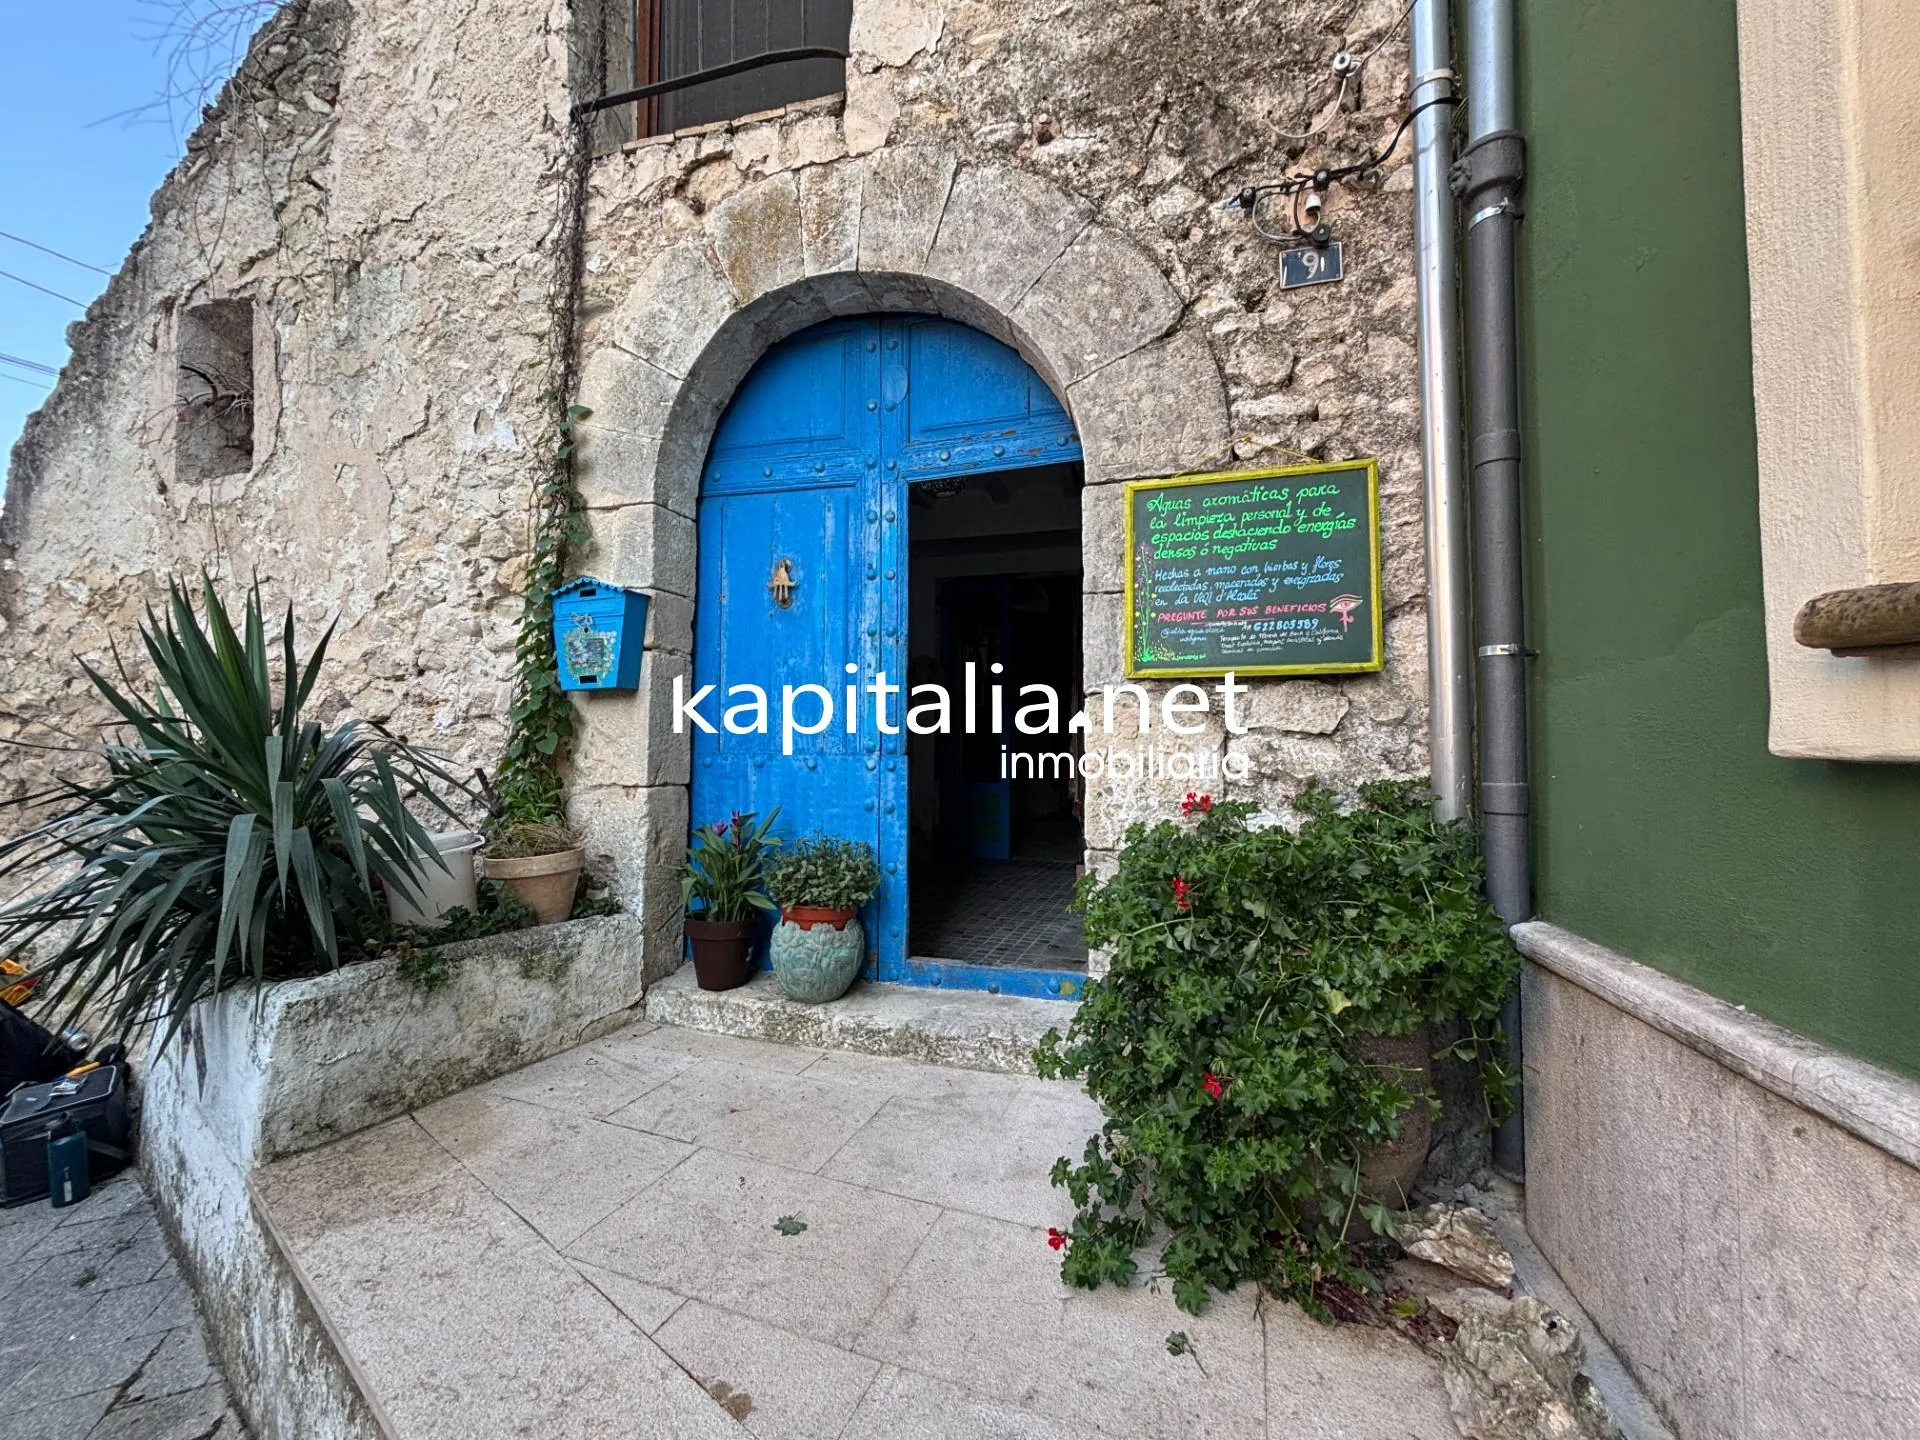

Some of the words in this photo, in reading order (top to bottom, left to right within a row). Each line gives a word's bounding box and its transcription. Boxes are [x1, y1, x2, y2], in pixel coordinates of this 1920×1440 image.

[1146, 492, 1192, 517] Aguas
[1202, 485, 1290, 507] aromáticas
[1296, 484, 1340, 504] para
[1150, 517, 1167, 529] la
[1173, 510, 1235, 530] limpieza
[1241, 500, 1292, 528] personal
[1294, 509, 1307, 526] y
[1312, 501, 1332, 516] de
[1151, 529, 1209, 548] espacios
[1213, 519, 1291, 539] deshaciendo
[1297, 512, 1357, 538] energías
[1154, 543, 1197, 559] densas
[1212, 537, 1278, 560] negativas
[1155, 567, 1190, 581] Hechas
[1193, 568, 1201, 577] a
[1205, 565, 1236, 576] mano
[1241, 565, 1259, 575] con
[1264, 560, 1299, 574] hierbas
[1301, 562, 1308, 575] y
[1312, 555, 1342, 573] flores
[1268, 577, 1279, 593] y
[1155, 598, 1168, 606] en
[1158, 609, 1207, 622] PREGUNTE
[1216, 607, 1236, 618] POR
[1239, 606, 1259, 616] SUS
[1265, 603, 1327, 614] BENEFICIOS
